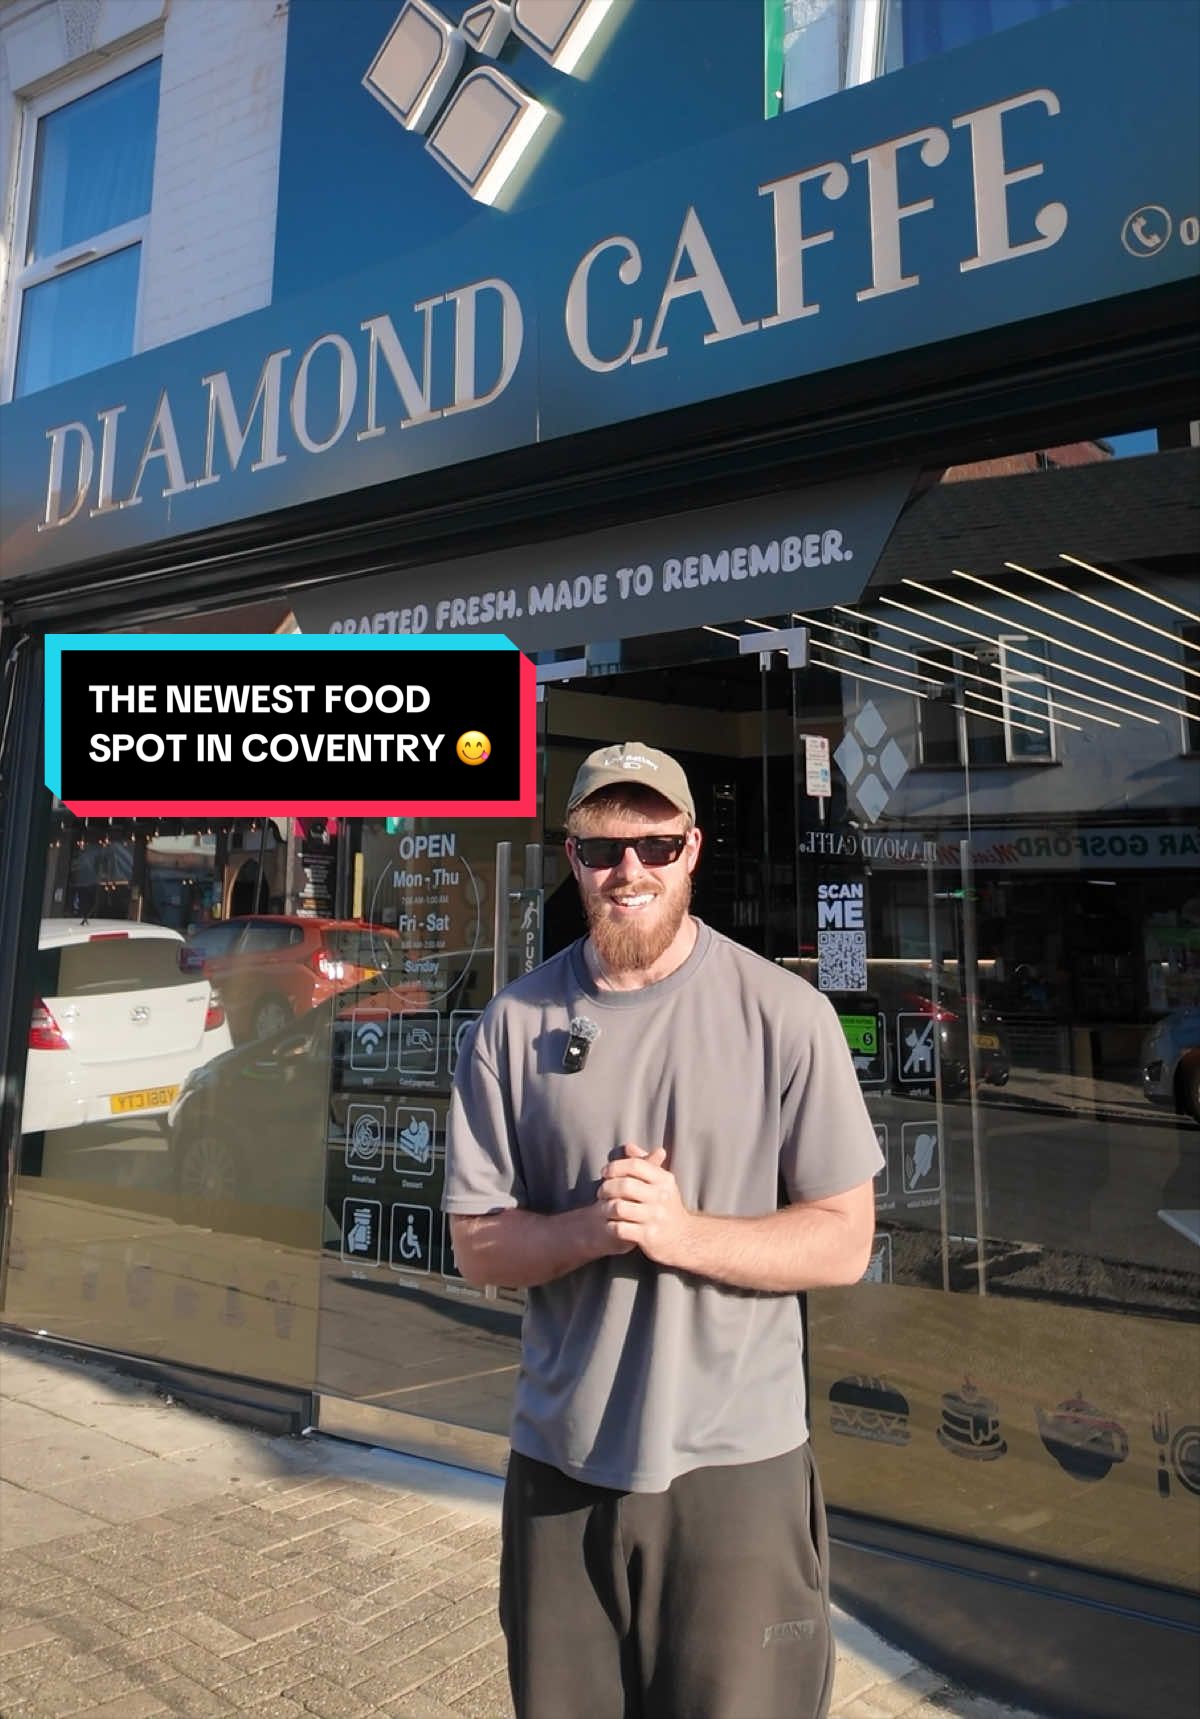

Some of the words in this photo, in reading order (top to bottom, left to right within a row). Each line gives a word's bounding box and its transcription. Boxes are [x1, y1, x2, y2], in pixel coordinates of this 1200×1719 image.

[37, 276, 523, 532] DIAMOND
[565, 89, 1068, 372] CAFFE
[436, 589, 522, 631] FRESH.
[528, 573, 608, 616] MADE
[616, 564, 653, 599] TO
[662, 529, 853, 592] REMEMBER.
[400, 833, 456, 860] OPEN
[393, 871, 423, 888] Mon
[432, 869, 459, 886] Thu
[817, 883, 863, 899] SCAN
[399, 915, 417, 932] Fri
[426, 913, 450, 932] Sat
[817, 900, 864, 929] ME
[524, 931, 534, 973] PUS
